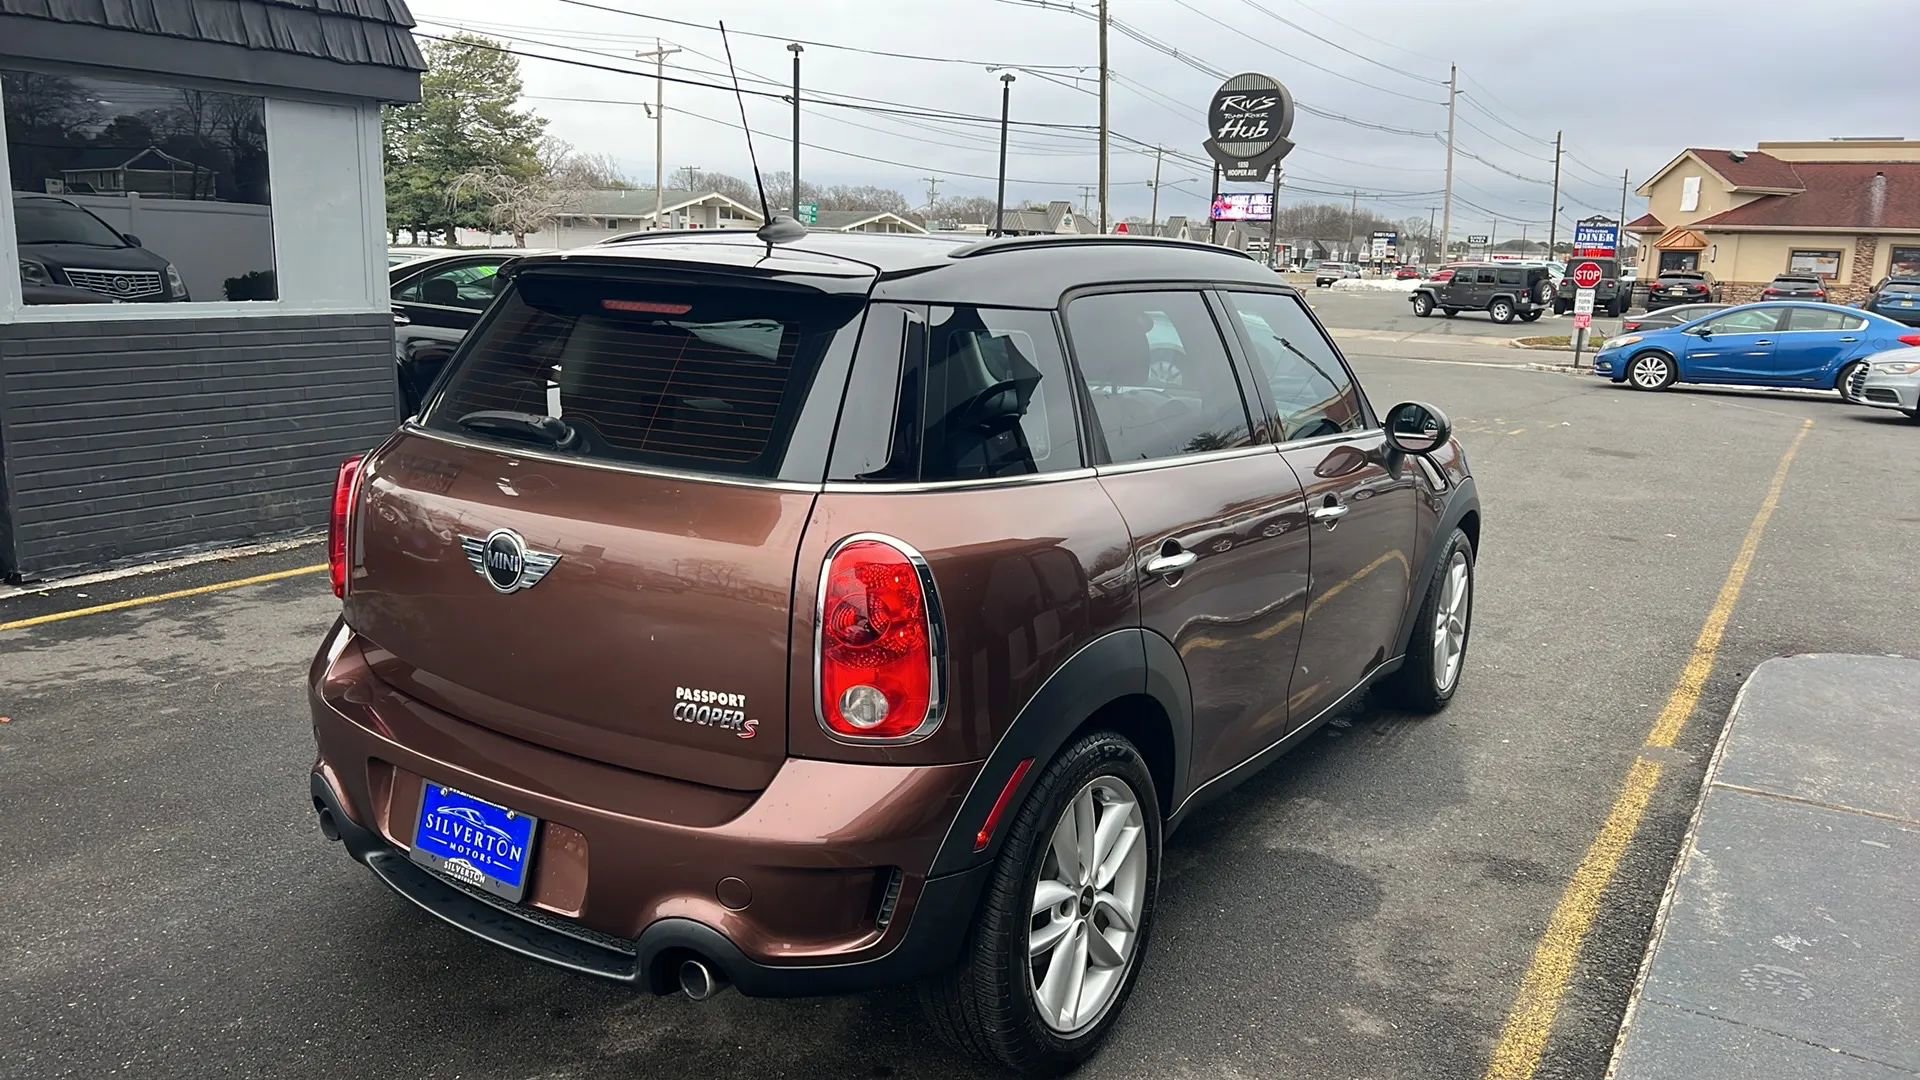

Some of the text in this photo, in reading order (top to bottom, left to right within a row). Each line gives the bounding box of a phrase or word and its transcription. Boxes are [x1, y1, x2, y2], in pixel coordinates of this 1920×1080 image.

[1219, 95, 1279, 112] Riv's
[1218, 118, 1269, 139] Hub
[1578, 232, 1614, 242] DINER
[1374, 249, 1384, 257] 35
[1576, 270, 1600, 280] STOP
[487, 550, 519, 572] MINI
[675, 686, 746, 708] PASSPORT
[673, 702, 745, 731] COOPER
[425, 813, 522, 862] SILVERTON
[449, 842, 491, 864] MOTORS
[443, 860, 486, 884] SILVERTON
